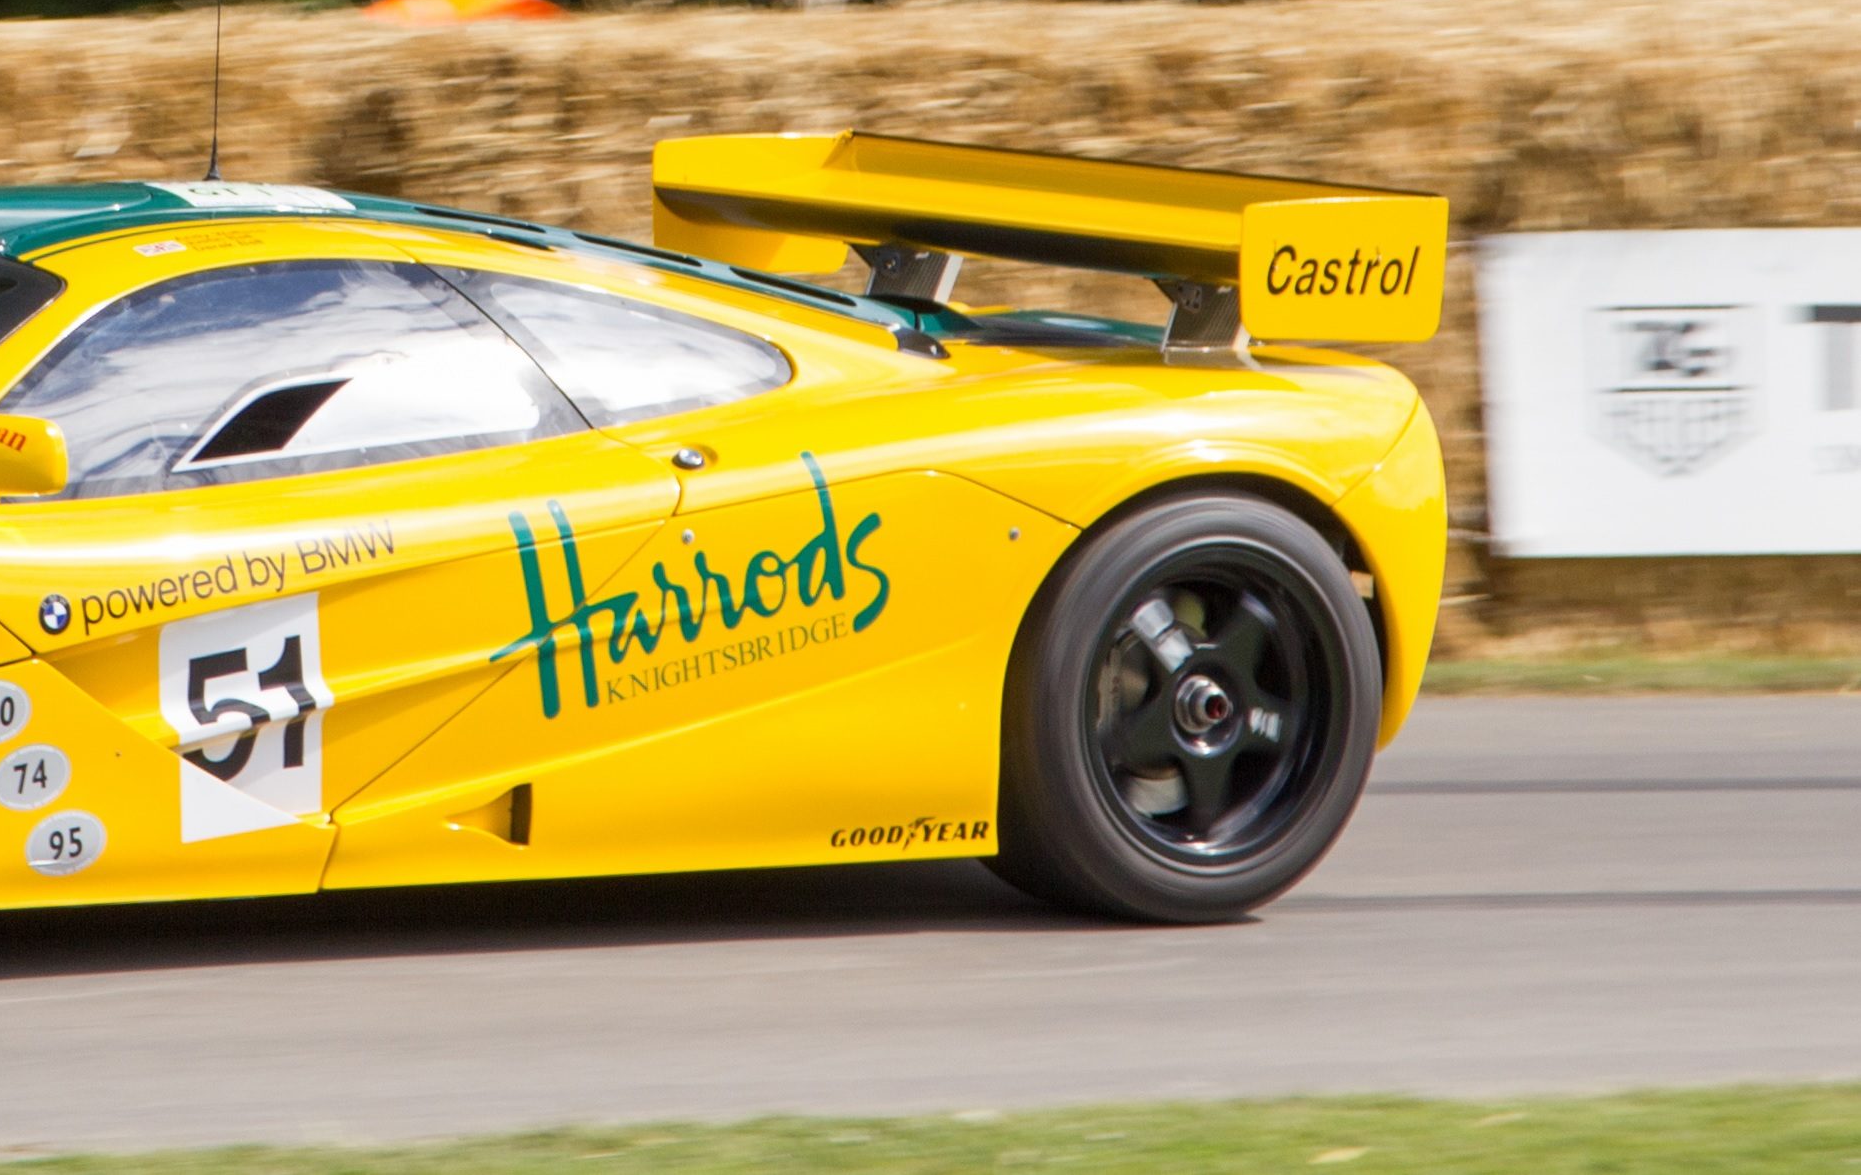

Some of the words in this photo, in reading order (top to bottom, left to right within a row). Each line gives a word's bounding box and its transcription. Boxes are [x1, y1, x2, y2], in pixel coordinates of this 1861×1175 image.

[1266, 244, 1421, 296] Castrol
[80, 554, 239, 636] powered
[243, 550, 287, 592] by
[295, 519, 396, 575] BMW
[489, 450, 890, 719] Harrods
[606, 611, 850, 705] KNIGHTSBRIDGE
[182, 634, 317, 783] 51
[12, 758, 48, 795] 74
[48, 826, 84, 861] 95
[830, 820, 991, 848] GOODYEAR
